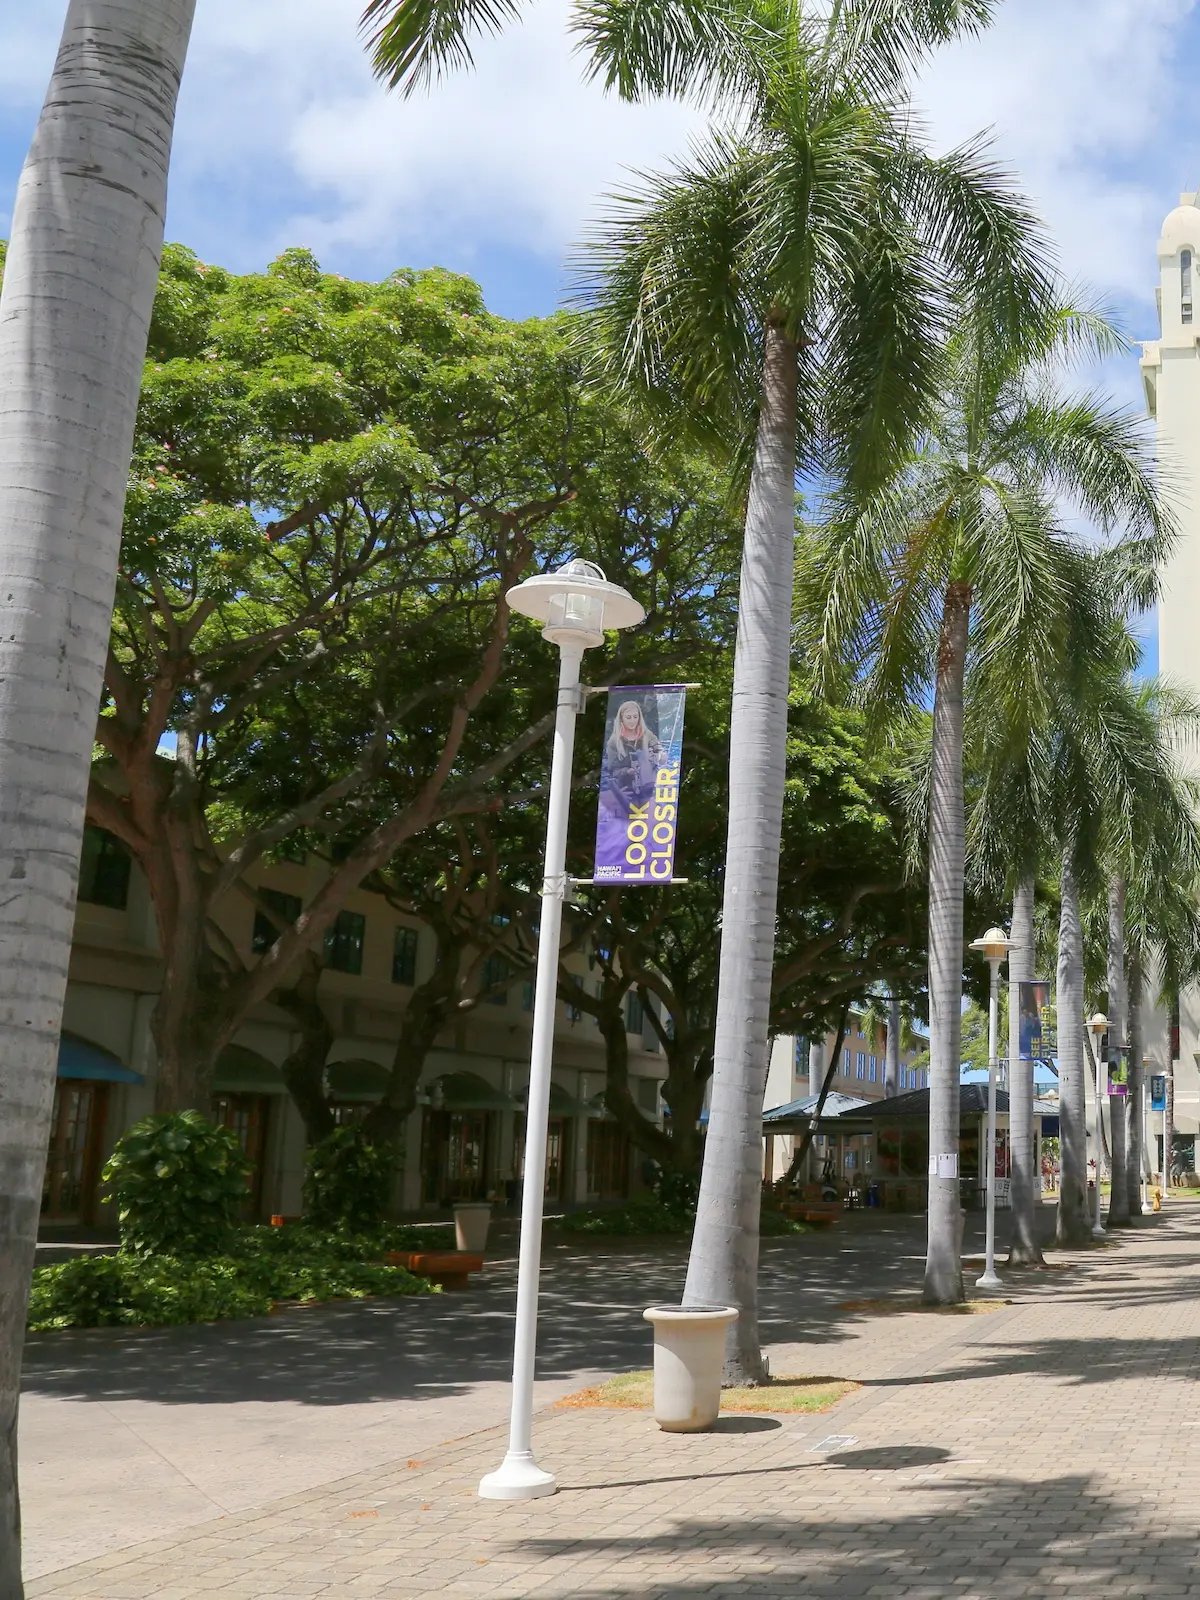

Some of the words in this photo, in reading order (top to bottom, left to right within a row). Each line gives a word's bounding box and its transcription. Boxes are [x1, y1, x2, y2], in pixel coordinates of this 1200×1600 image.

[624, 801, 649, 879] LOOK
[650, 761, 680, 879] CLOSER.
[1031, 1037, 1041, 1058] SEE
